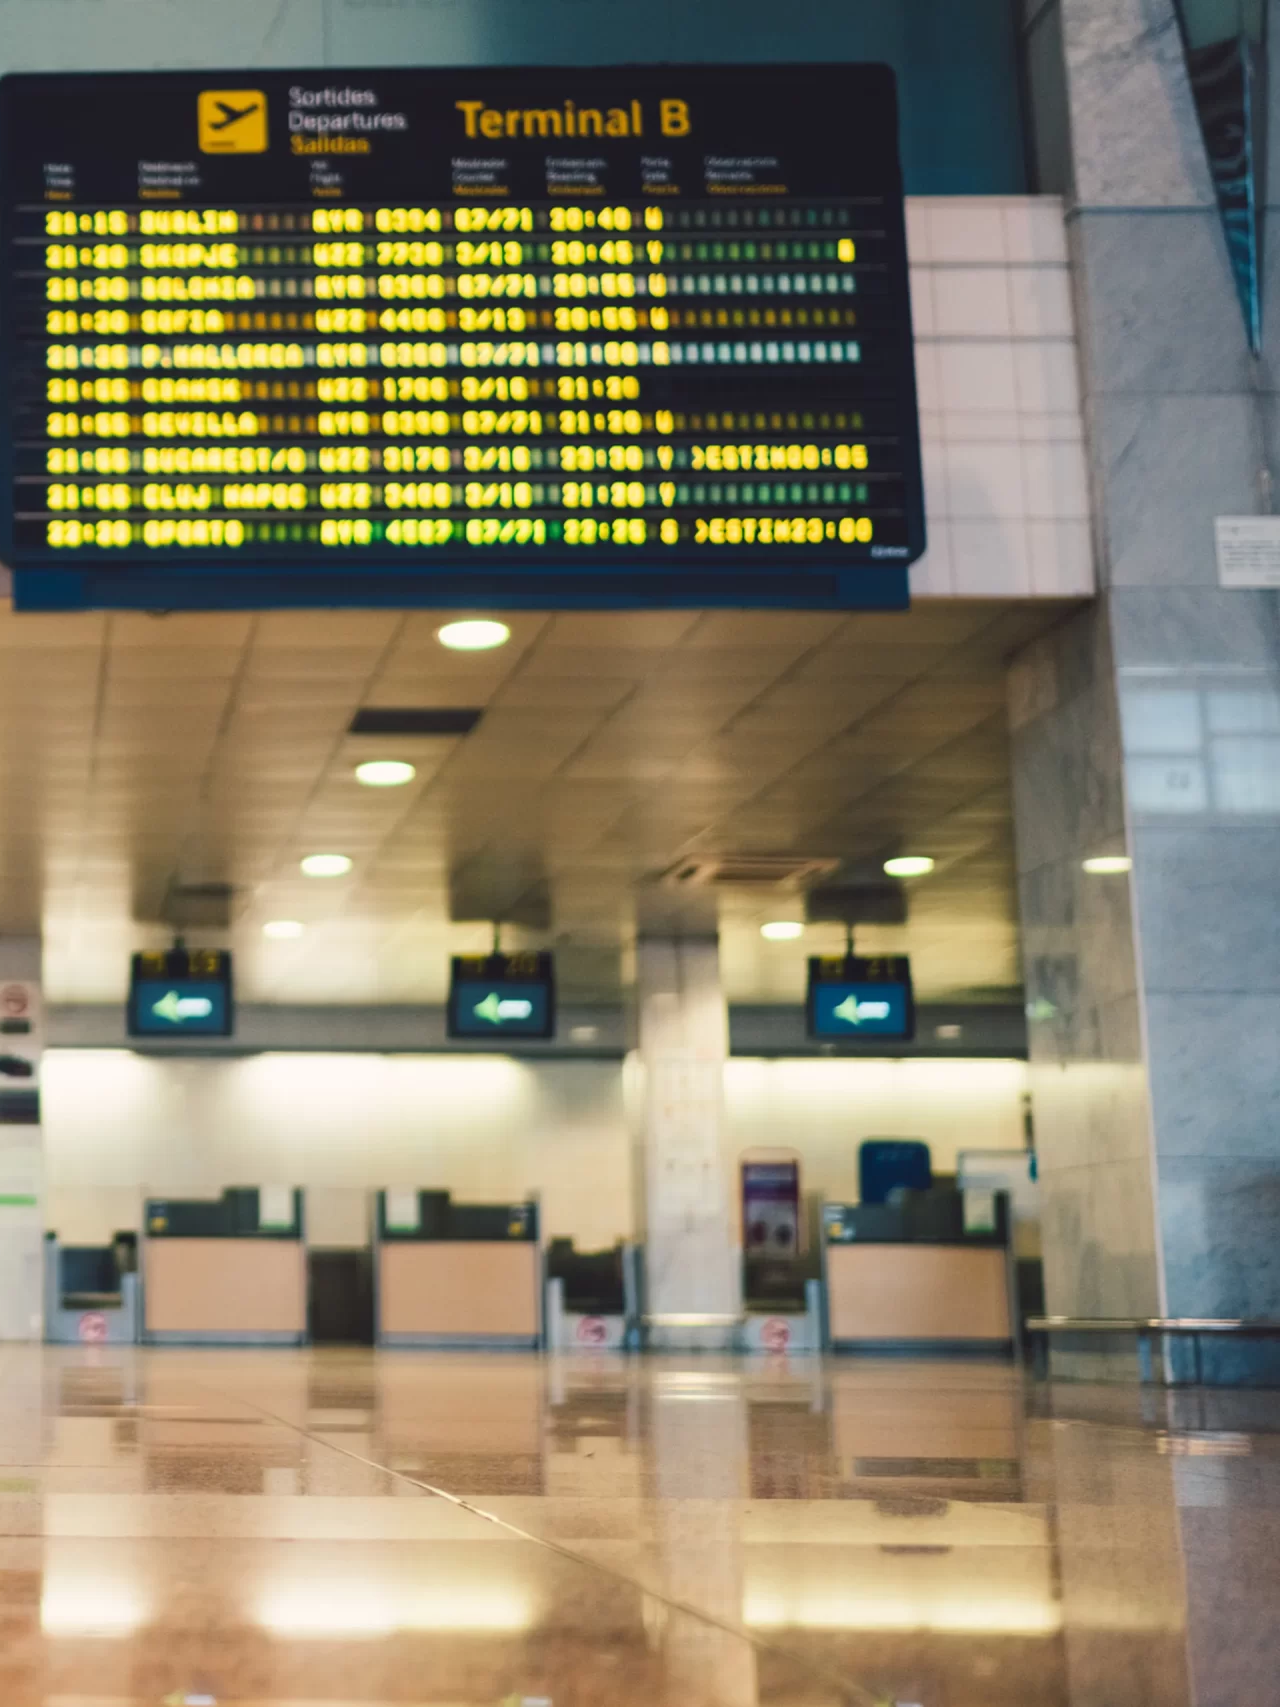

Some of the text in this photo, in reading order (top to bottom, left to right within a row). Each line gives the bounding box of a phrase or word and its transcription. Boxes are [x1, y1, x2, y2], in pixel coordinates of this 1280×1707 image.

[288, 86, 377, 107] Sortides
[288, 110, 408, 132] Departures
[455, 98, 691, 138] Terminal B
[290, 134, 371, 155] Salidas
[45, 210, 128, 236] 21:15
[139, 209, 239, 235] DUBLIN
[549, 206, 632, 231] 20:40
[46, 244, 129, 269] 21:20
[139, 243, 238, 269] SKOPJE
[47, 277, 129, 301] 21:30
[46, 309, 130, 334] 21:30
[140, 309, 225, 334] SOFIA
[142, 377, 242, 403] GDANSK
[142, 411, 260, 437] SEVILLA
[142, 483, 212, 510] CLUJ
[142, 519, 245, 547] OPORTO
